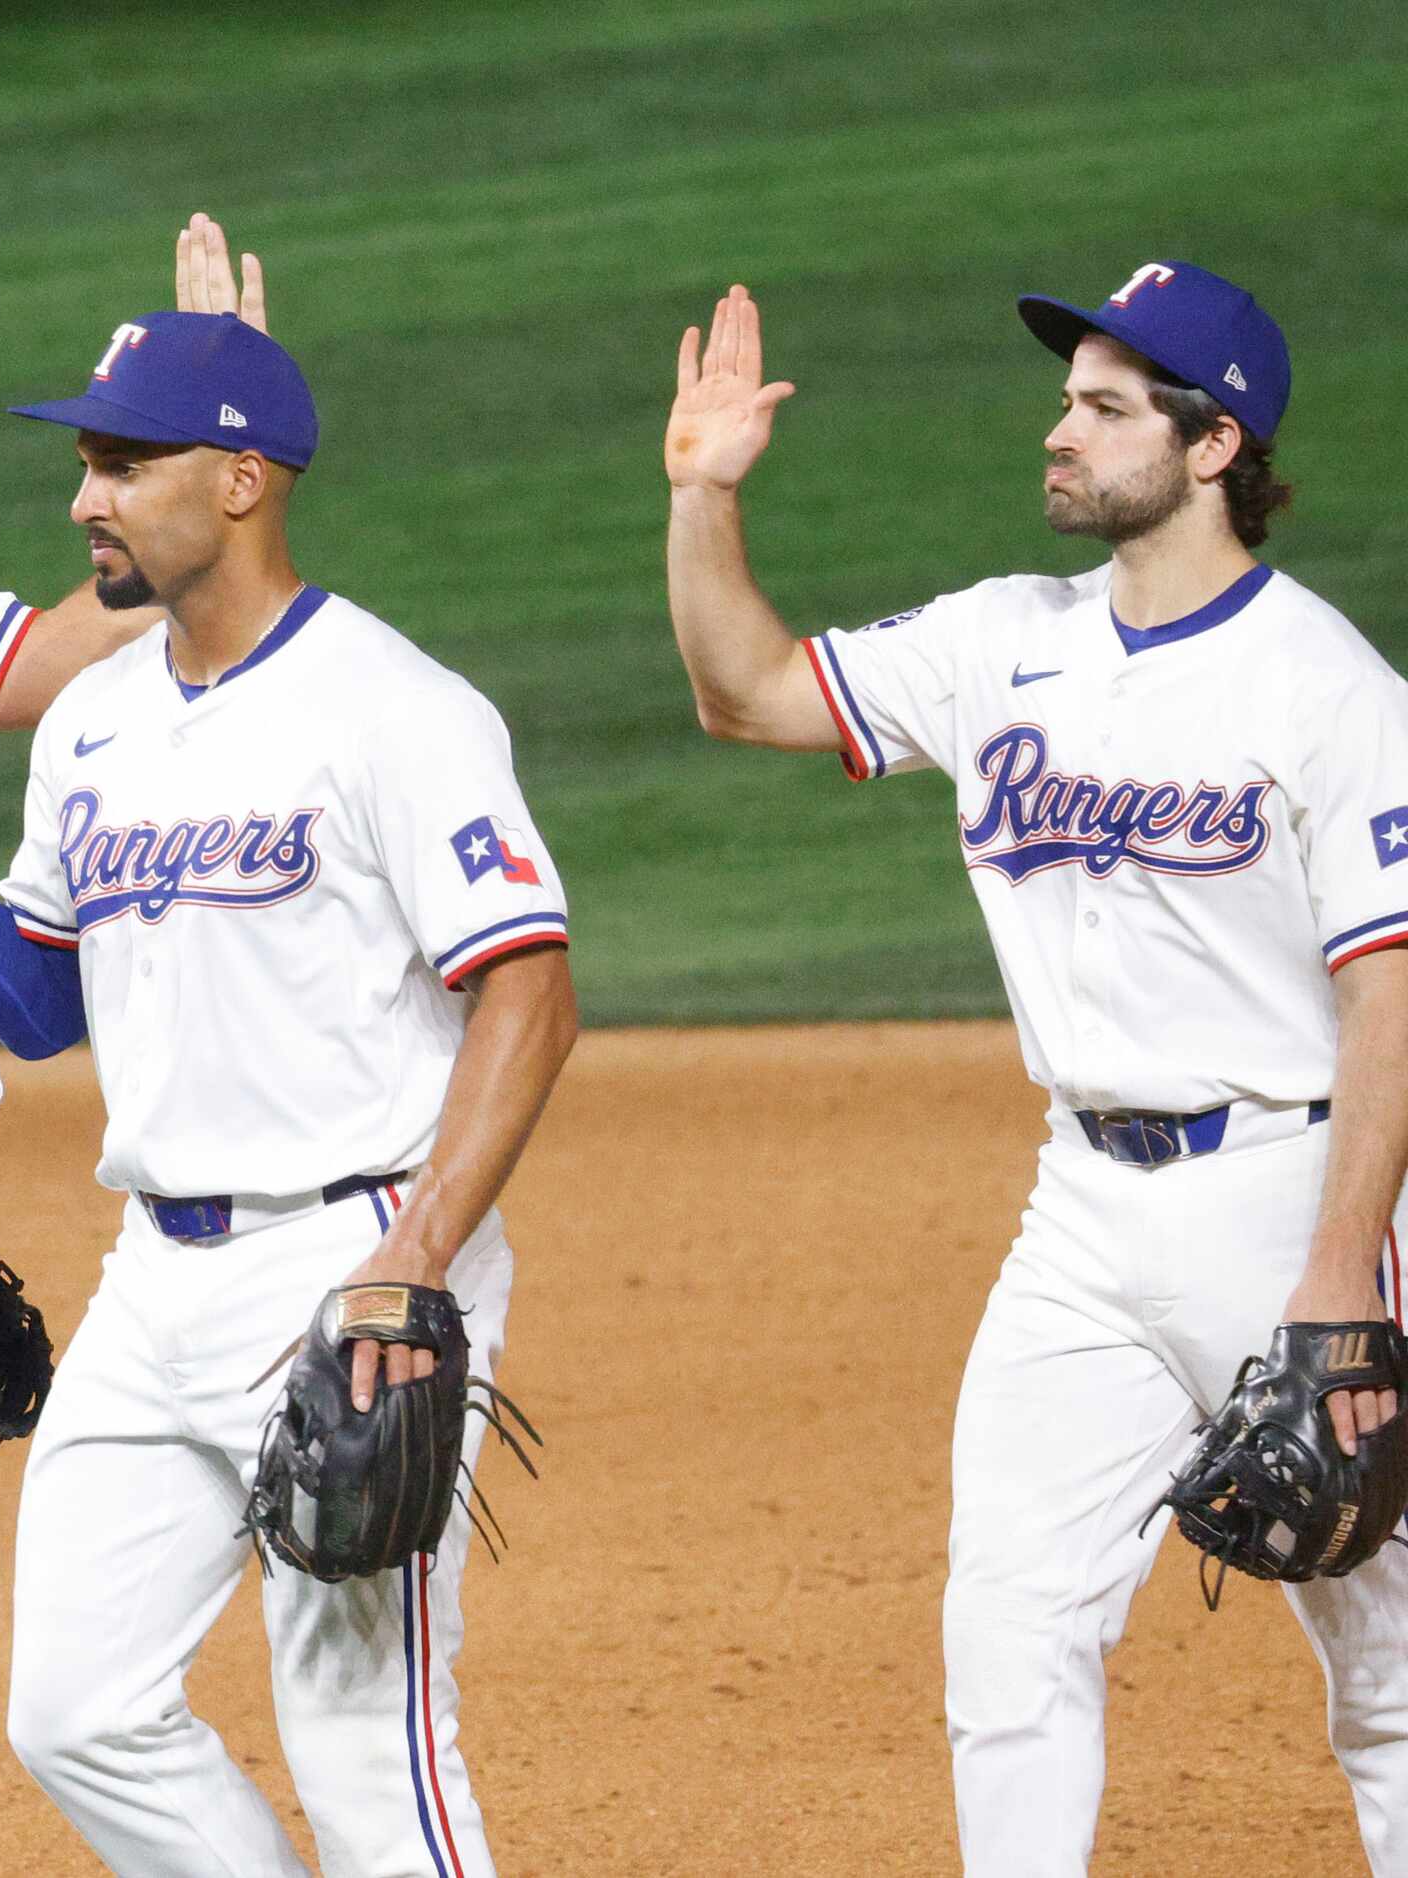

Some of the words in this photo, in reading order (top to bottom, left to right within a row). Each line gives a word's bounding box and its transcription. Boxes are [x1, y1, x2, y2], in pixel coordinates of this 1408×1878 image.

[1109, 263, 1178, 308] T
[94, 323, 151, 382] T
[960, 722, 1275, 882] Rangers
[59, 786, 324, 926] Rangers
